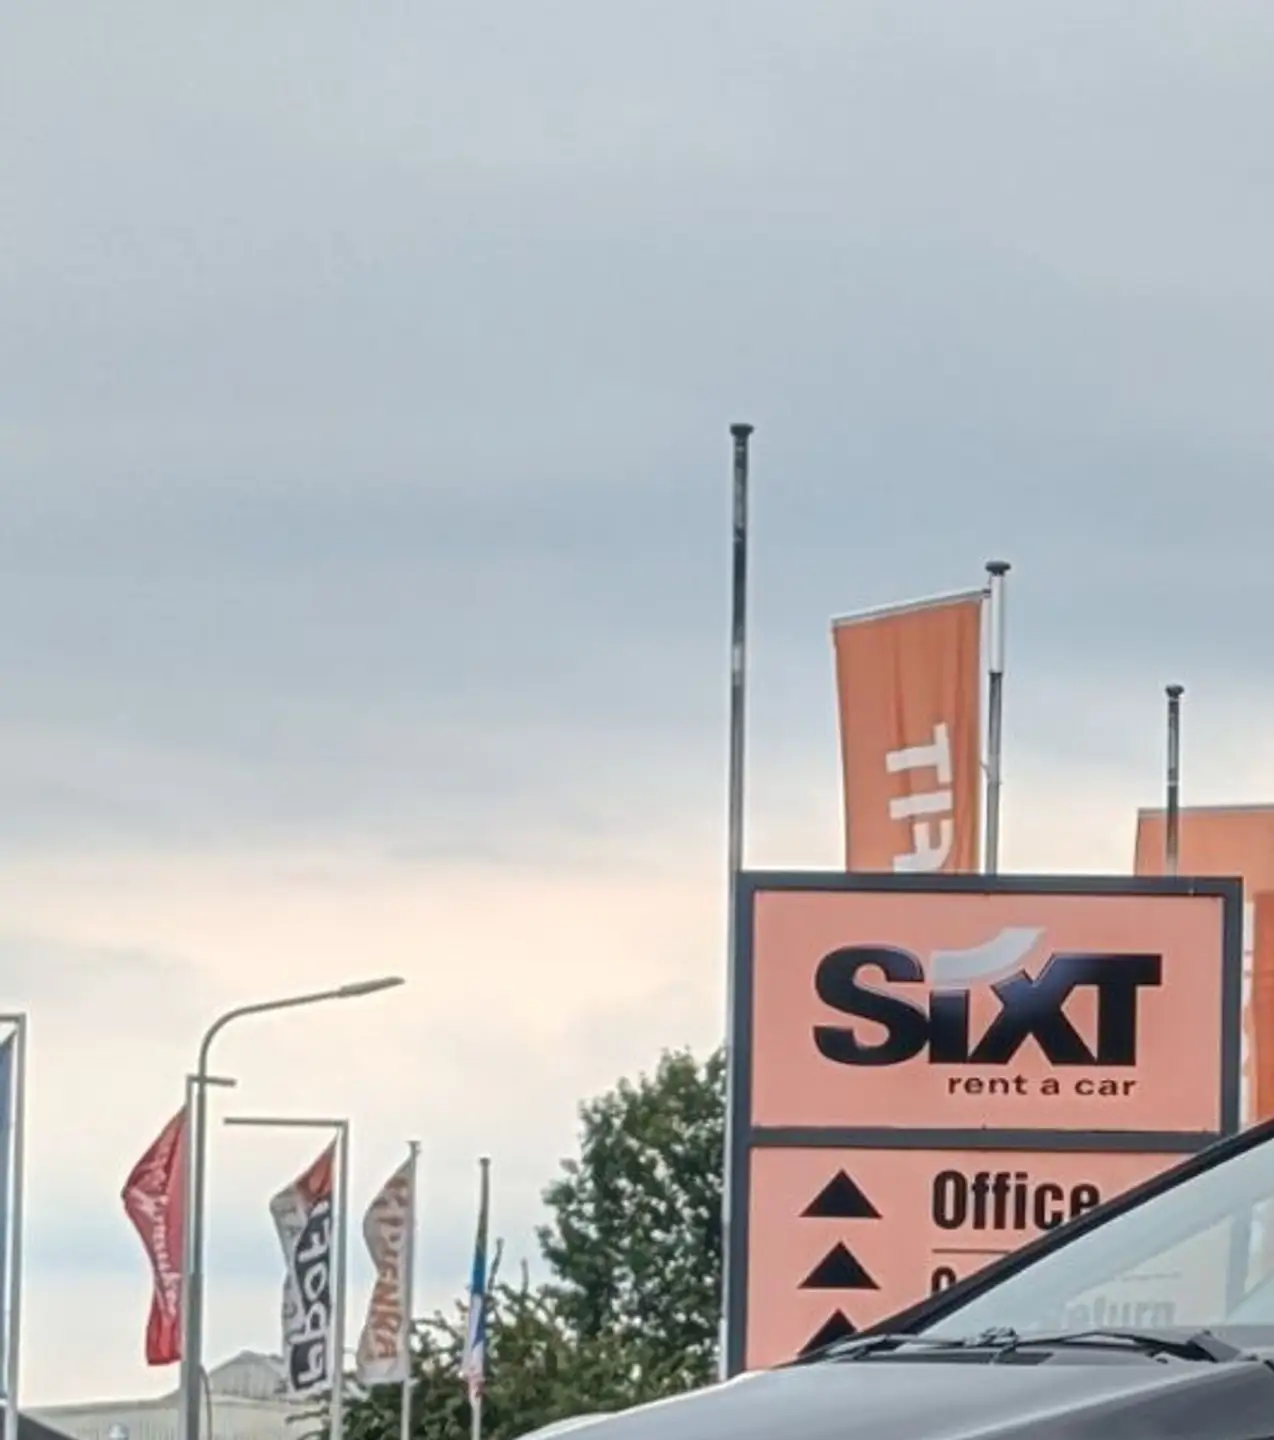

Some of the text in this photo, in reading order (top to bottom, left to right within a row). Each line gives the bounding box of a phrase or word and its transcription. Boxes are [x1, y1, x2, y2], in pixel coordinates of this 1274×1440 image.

[948, 1074, 1137, 1097] rent a car
[932, 1170, 1101, 1230] Office
